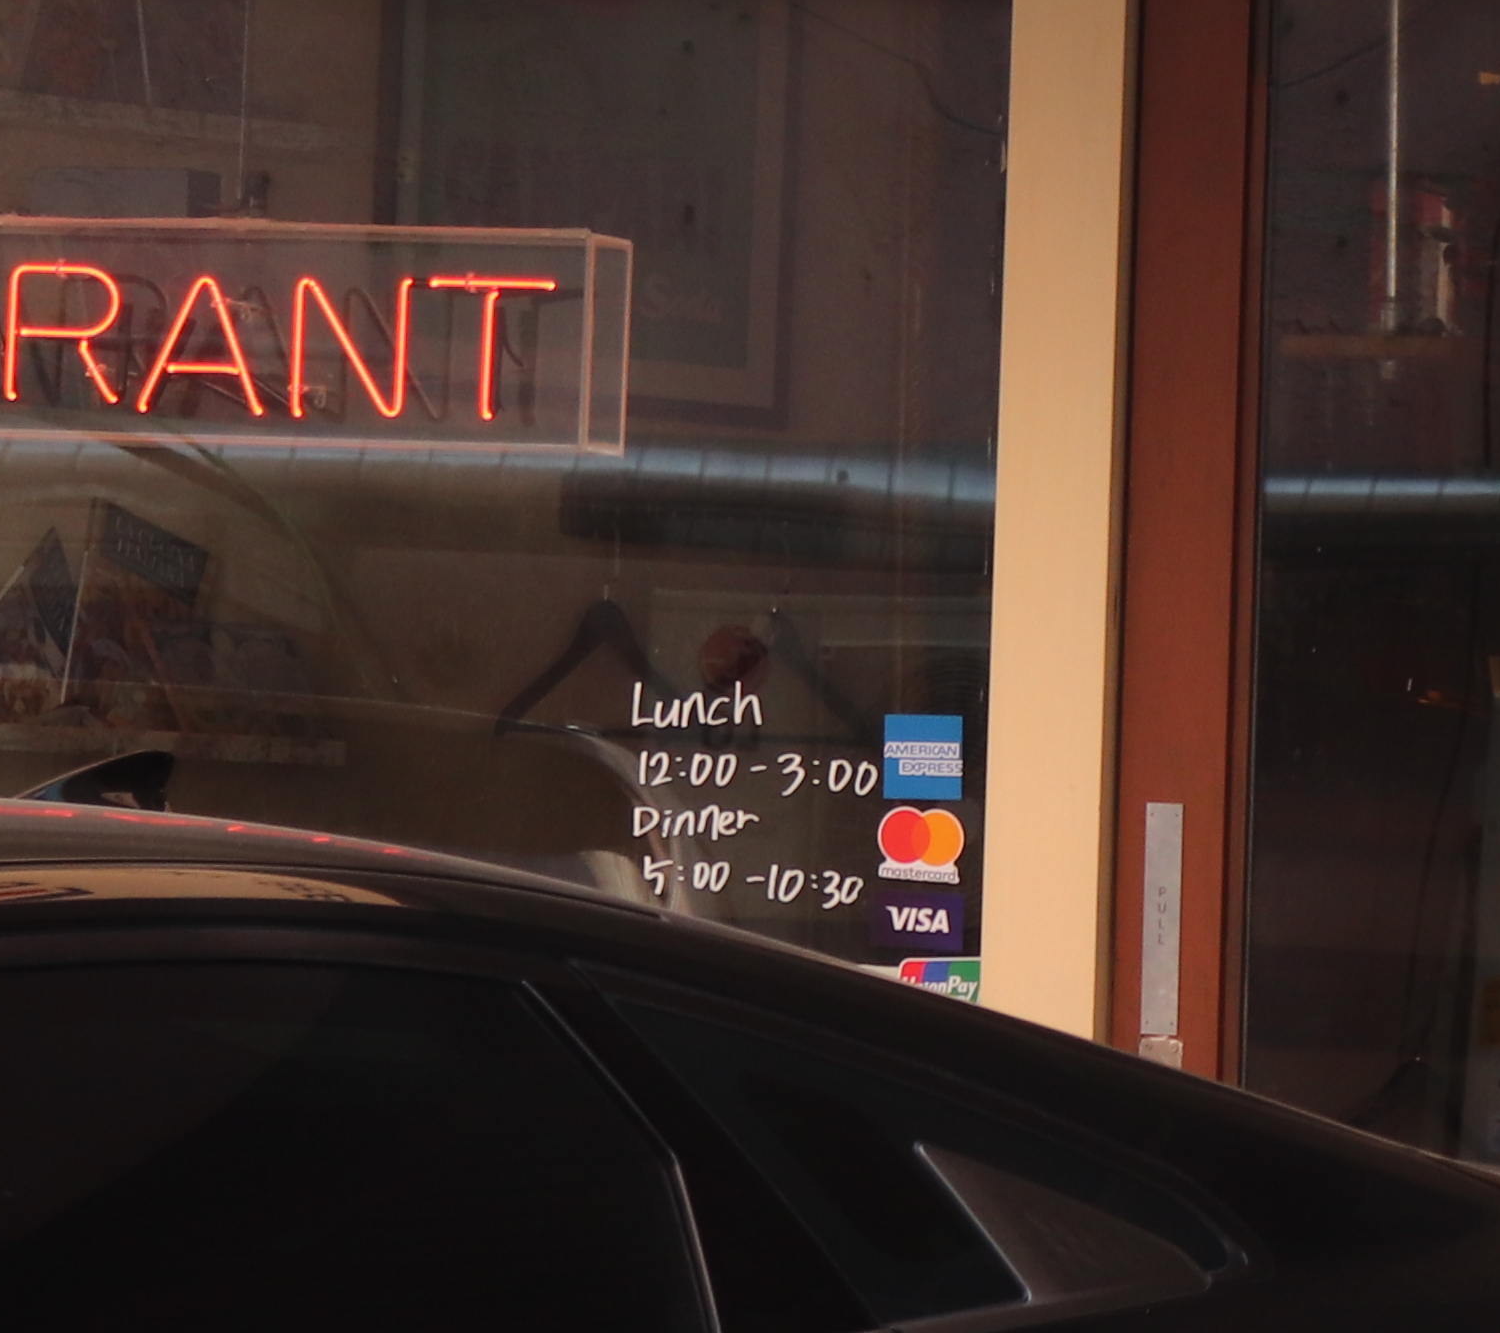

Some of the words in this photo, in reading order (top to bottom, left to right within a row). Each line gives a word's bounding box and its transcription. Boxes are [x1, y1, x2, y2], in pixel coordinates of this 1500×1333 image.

[632, 681, 764, 728] Lunch
[884, 744, 958, 758] AMERICAN
[638, 750, 738, 787] 12:00
[777, 752, 879, 796] 3:00
[901, 761, 963, 775] EXPRESS
[633, 804, 760, 841] Dinner
[643, 855, 731, 894] 5:00
[880, 865, 958, 883] mastercard
[886, 905, 950, 933] VISA
[1154, 885, 1169, 947] PULL
[901, 976, 978, 1001] onPay
